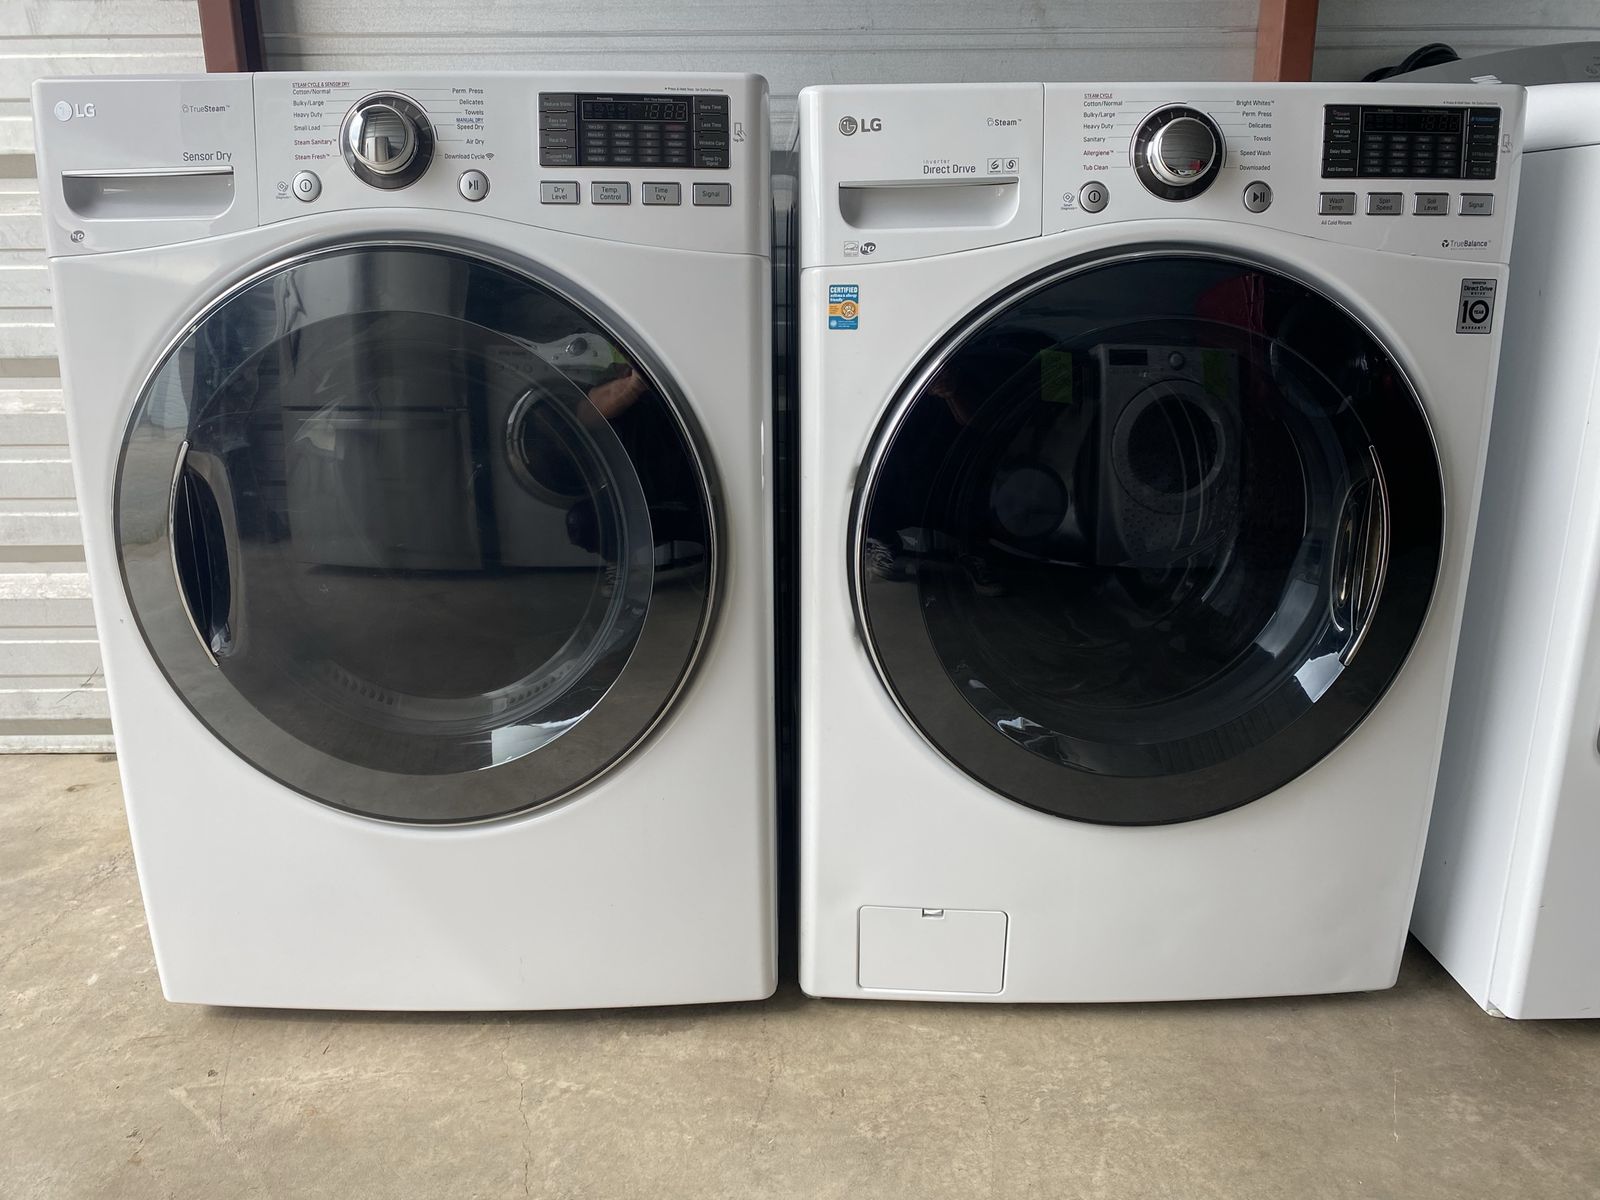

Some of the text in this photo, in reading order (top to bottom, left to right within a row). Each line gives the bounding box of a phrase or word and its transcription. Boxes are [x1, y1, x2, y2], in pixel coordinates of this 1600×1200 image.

[75, 104, 96, 118] LG
[293, 111, 322, 119] Heavy Duty
[861, 118, 882, 132] LG
[475, 138, 485, 147] Dry
[182, 150, 232, 162] Sensor Dry
[923, 164, 976, 174] Direct Drive
[554, 186, 565, 194] Dry
[702, 190, 720, 199] Signal
[551, 193, 568, 201] Level
[600, 193, 622, 201] Control
[656, 193, 667, 202] Dry
[1468, 201, 1485, 209] Signal
[830, 286, 858, 294] CERTIFIED
[1461, 300, 1490, 324] 10
